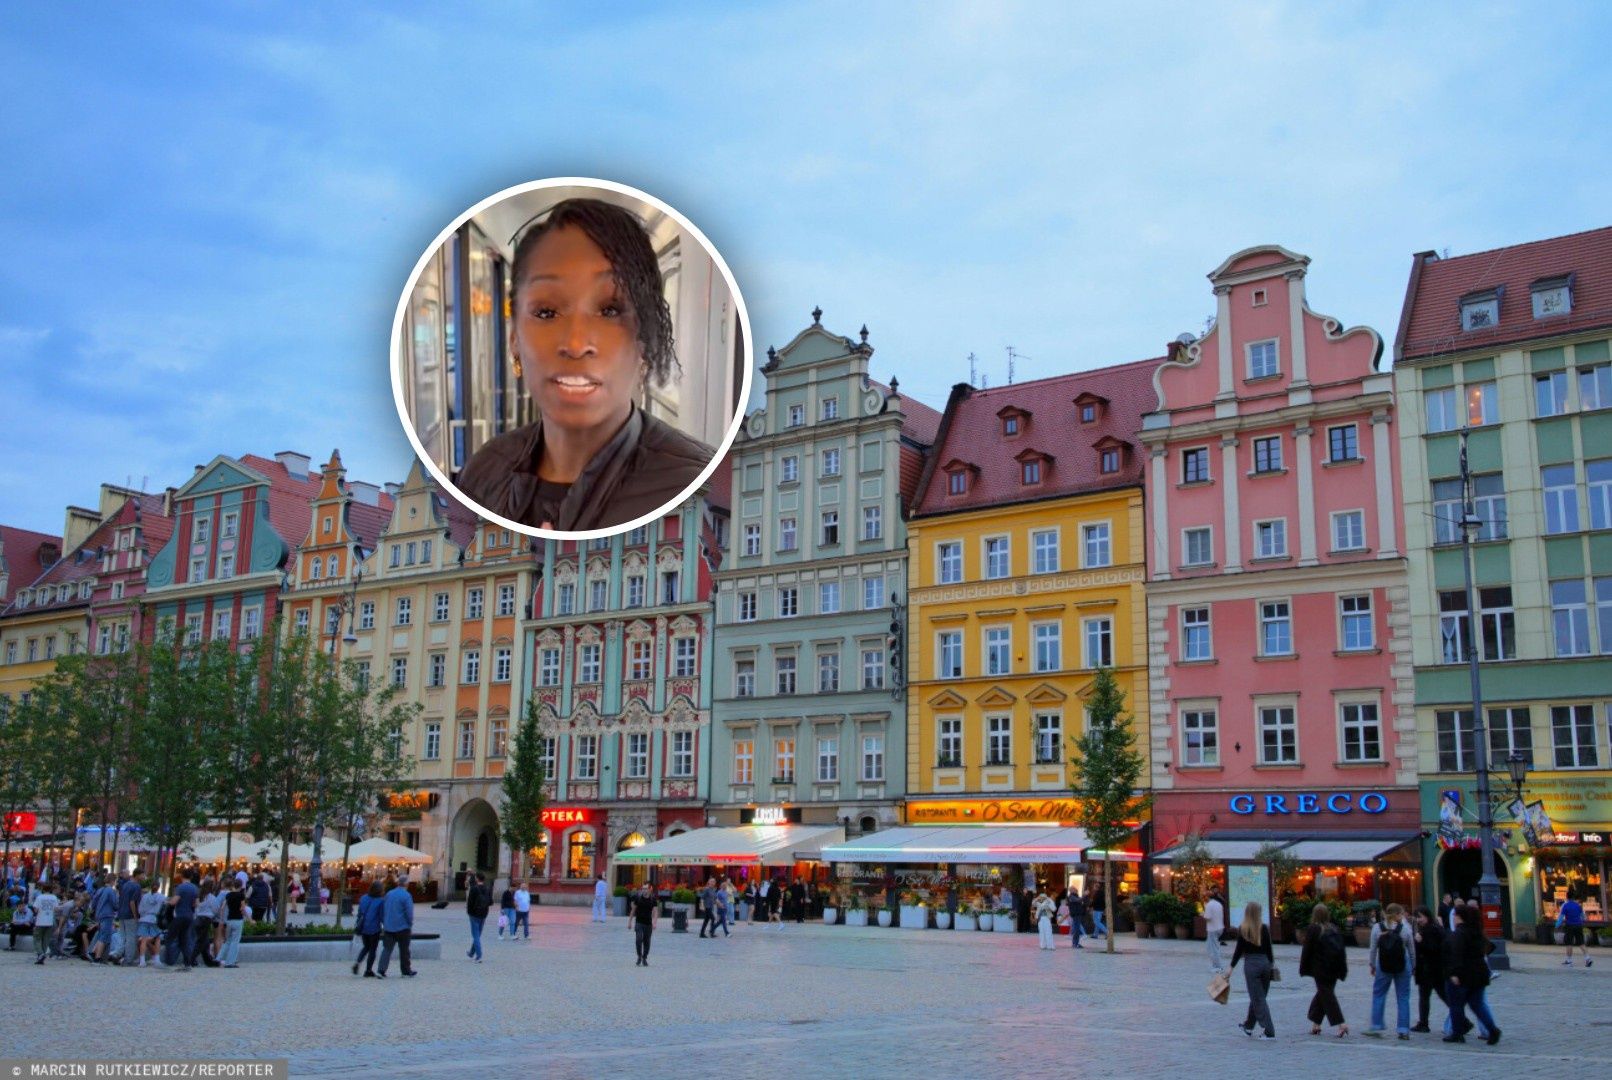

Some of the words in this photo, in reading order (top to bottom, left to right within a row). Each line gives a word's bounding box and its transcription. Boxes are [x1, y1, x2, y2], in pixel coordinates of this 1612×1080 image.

[1229, 792, 1389, 815] GRECO
[541, 810, 584, 822] PTEKA
[915, 808, 957, 818] RISTORANTE
[1003, 802, 1037, 821] Sole
